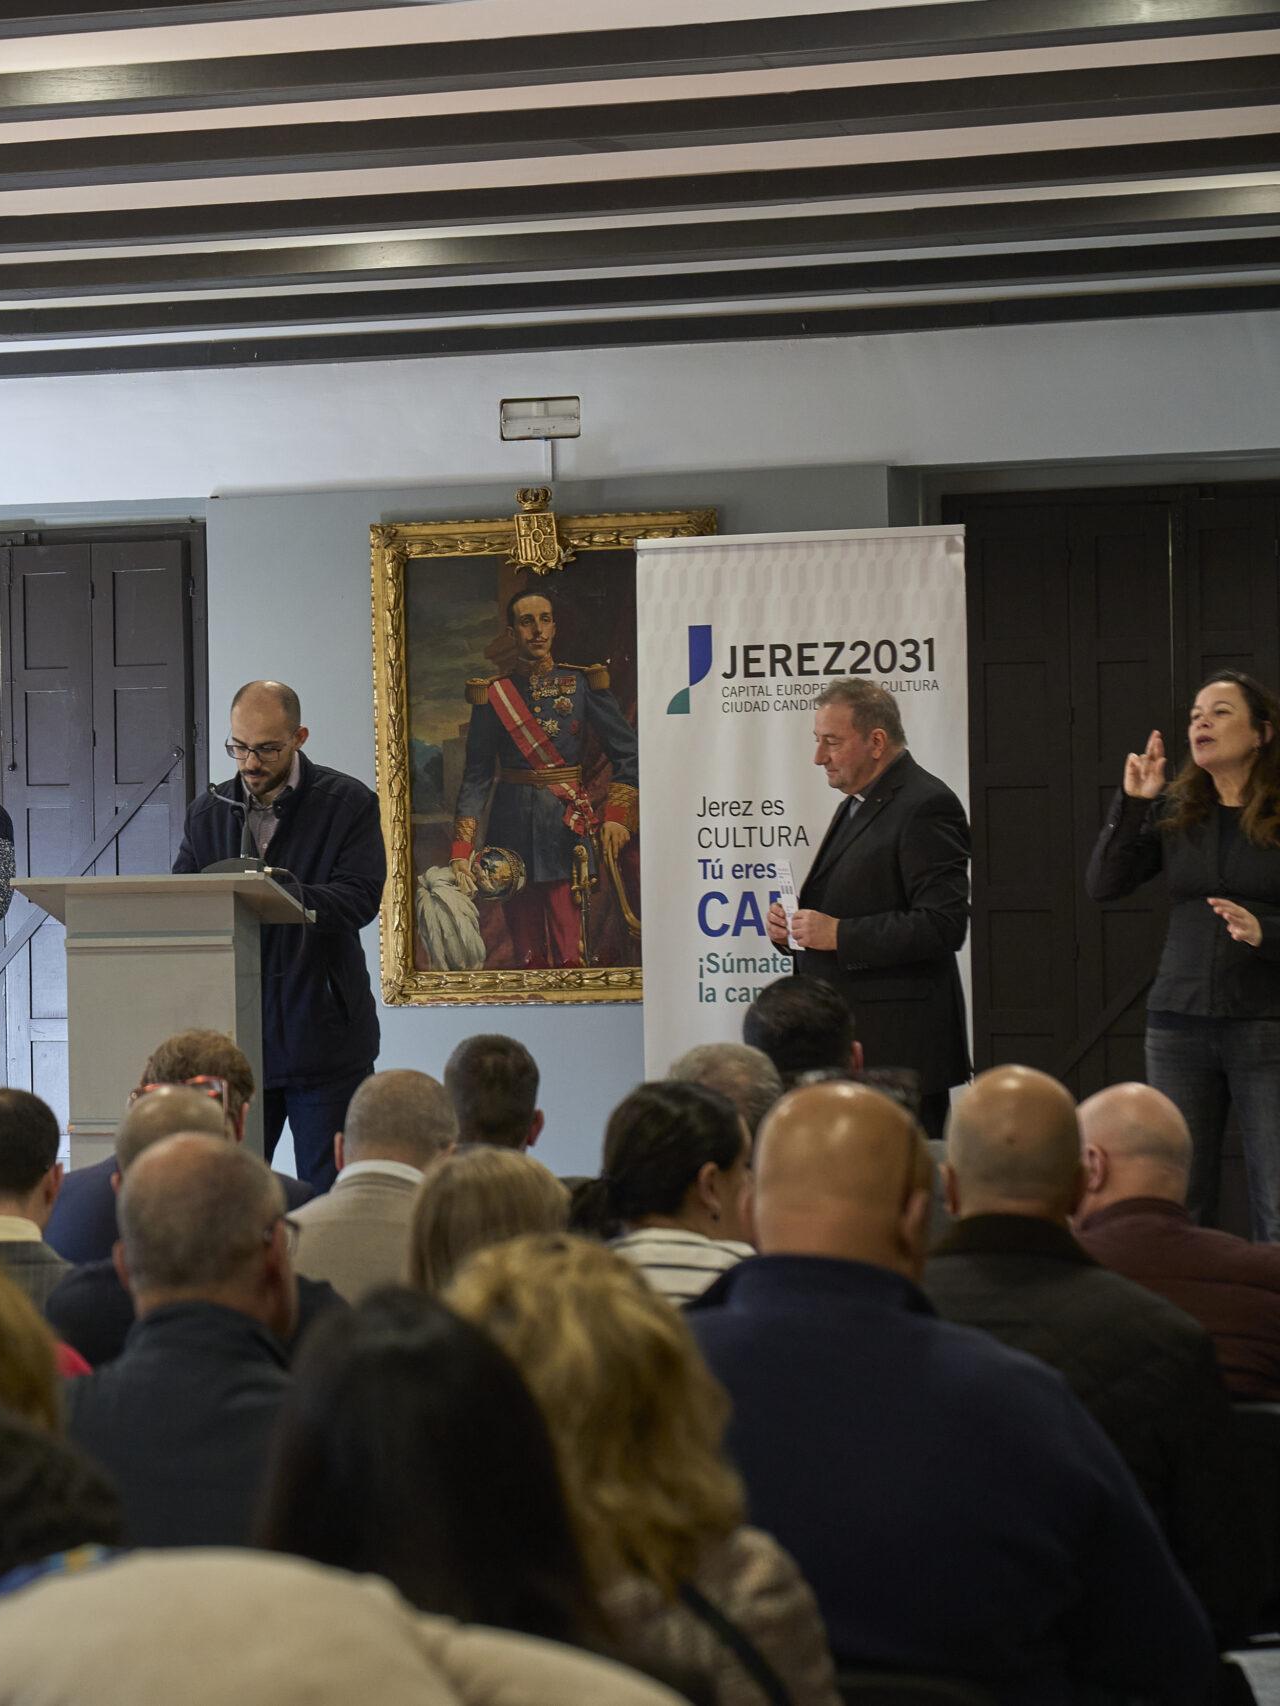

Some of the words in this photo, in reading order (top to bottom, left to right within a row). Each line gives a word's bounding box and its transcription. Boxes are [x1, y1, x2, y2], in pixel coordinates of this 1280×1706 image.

[721, 637, 935, 679] JEREZ2031
[721, 685, 773, 698] CAPITAL
[776, 683, 828, 696] EUROPE
[721, 701, 770, 713] CIUDAD
[696, 796, 753, 818] Jerez
[761, 799, 785, 816] es
[697, 825, 810, 849] CULTURA
[697, 858, 724, 880] Tú
[731, 862, 777, 879] eres
[698, 952, 792, 979] ¡Súmate
[698, 981, 716, 1003] la
